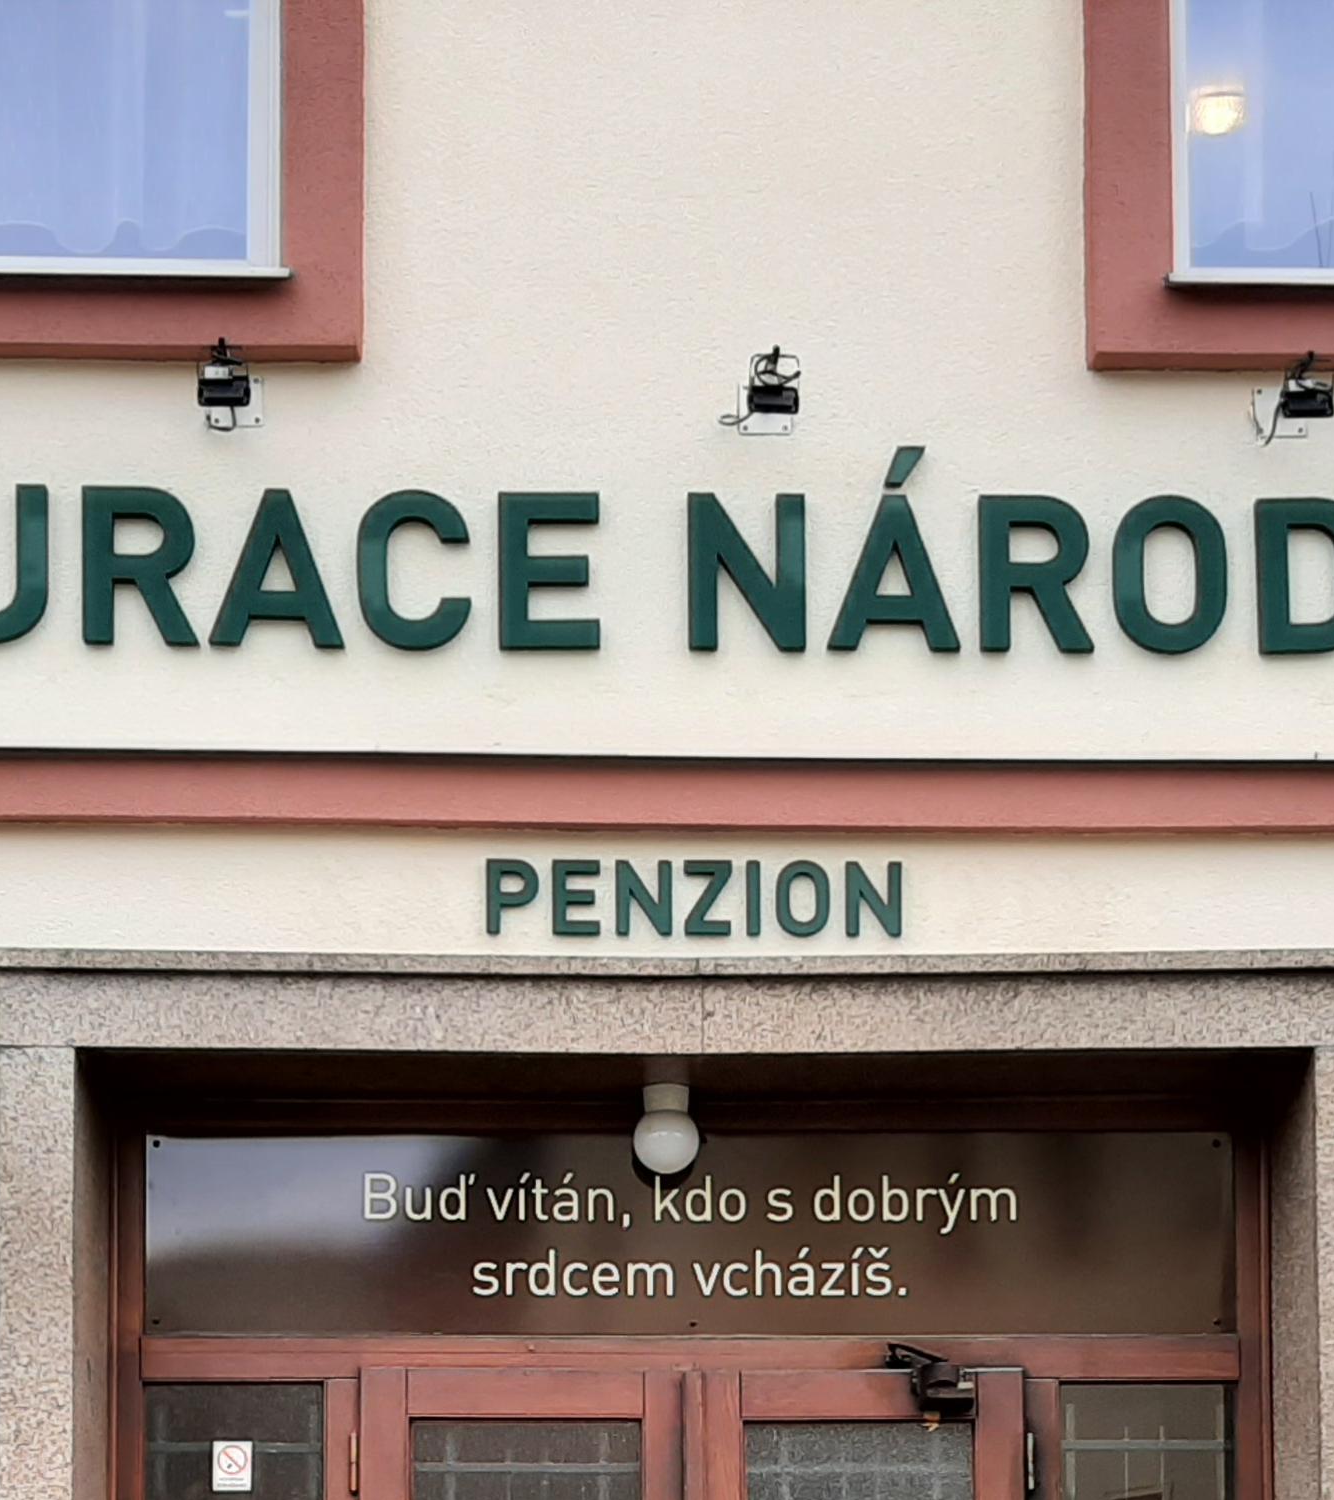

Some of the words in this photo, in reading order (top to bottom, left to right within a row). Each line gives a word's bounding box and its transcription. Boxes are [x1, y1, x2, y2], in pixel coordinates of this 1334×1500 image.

[485, 857, 904, 938] PENZION
[362, 1173, 477, 1222] Buď
[487, 1172, 631, 1229] vítán,
[653, 1175, 746, 1222] kdo
[767, 1187, 793, 1222] s
[814, 1172, 1017, 1234] dobrým
[472, 1248, 674, 1297] srdcem
[693, 1246, 908, 1297] vcházíš.
